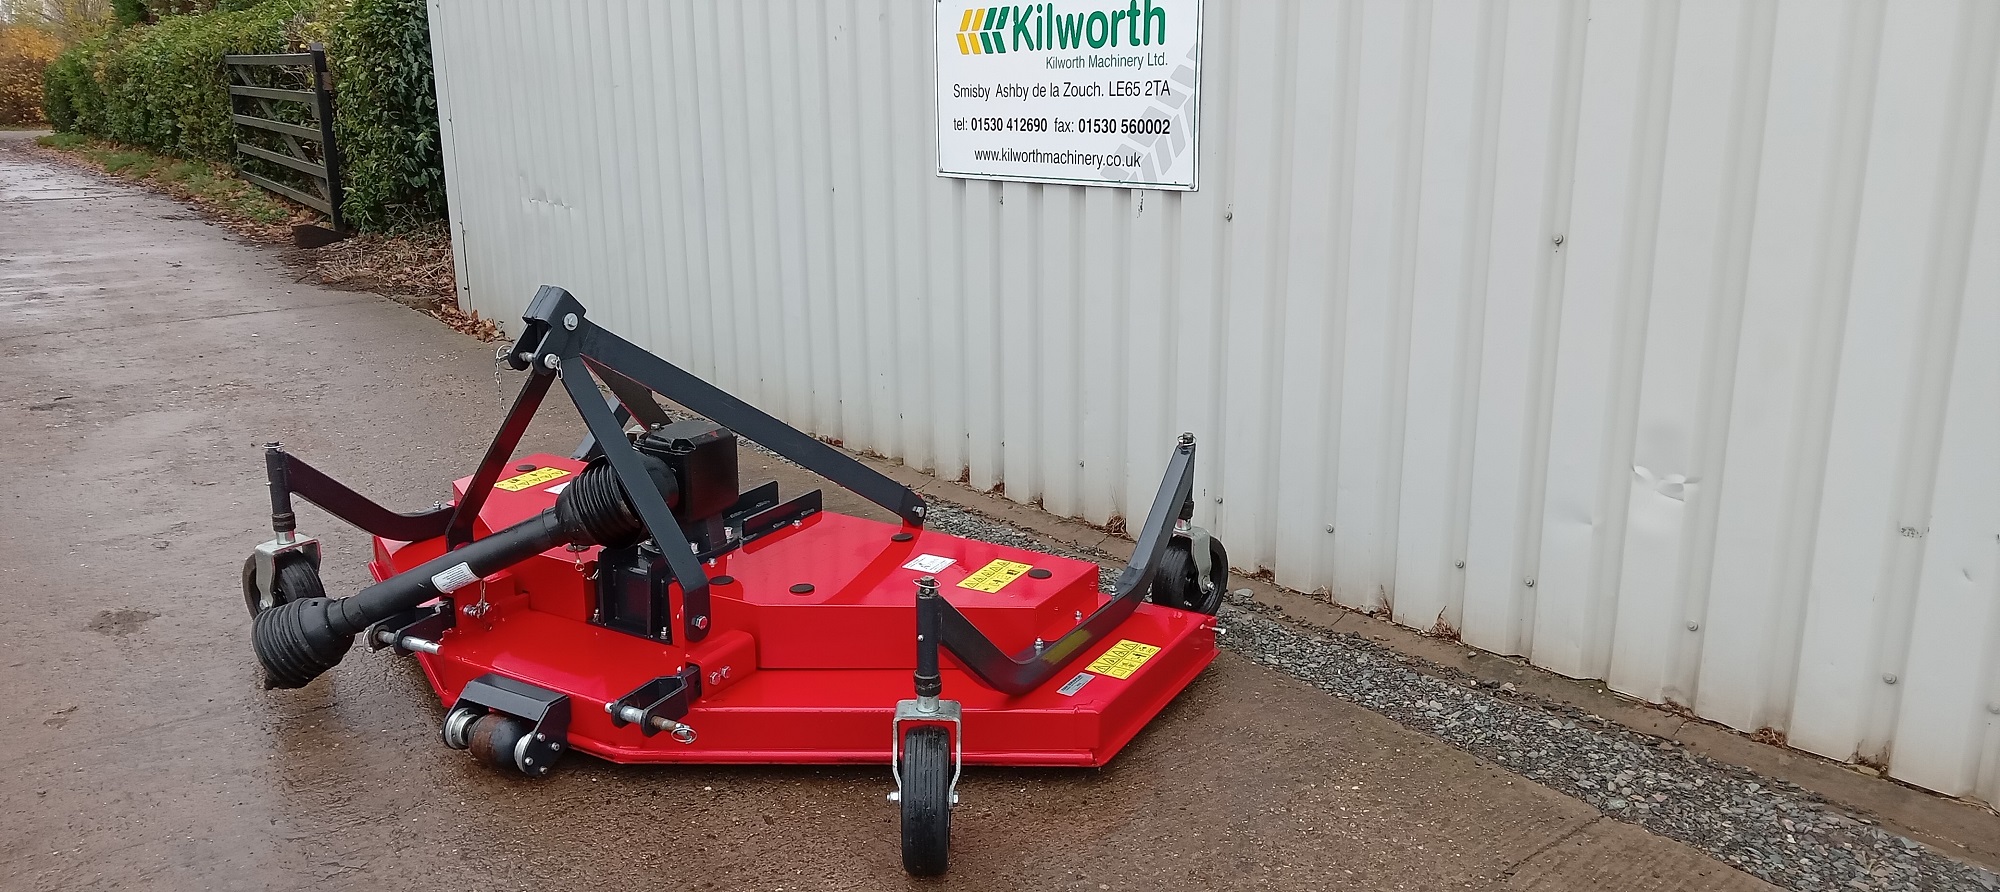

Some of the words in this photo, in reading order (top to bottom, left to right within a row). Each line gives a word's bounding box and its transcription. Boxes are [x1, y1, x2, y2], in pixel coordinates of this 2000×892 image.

[1013, 0, 1166, 51] Kilworth
[1046, 56, 1085, 70] Kilworth
[1088, 54, 1143, 71] Machinery
[1147, 53, 1168, 66] Ltd.
[953, 84, 991, 100] Smisby
[995, 83, 1029, 101] Ashby
[1032, 83, 1046, 97] de
[1050, 83, 1060, 97] la
[1063, 81, 1104, 97] Zouch.
[1109, 80, 1141, 97] LE65
[1145, 80, 1171, 96] 2TA
[953, 117, 968, 131] tel:
[971, 117, 1003, 132] 01530
[1006, 117, 1048, 132] 412690
[1054, 118, 1075, 133] fax:
[1078, 119, 1117, 134] 01530
[1121, 119, 1170, 134] 560002
[974, 147, 1141, 169] www.kilworthmachinery.co.uk
